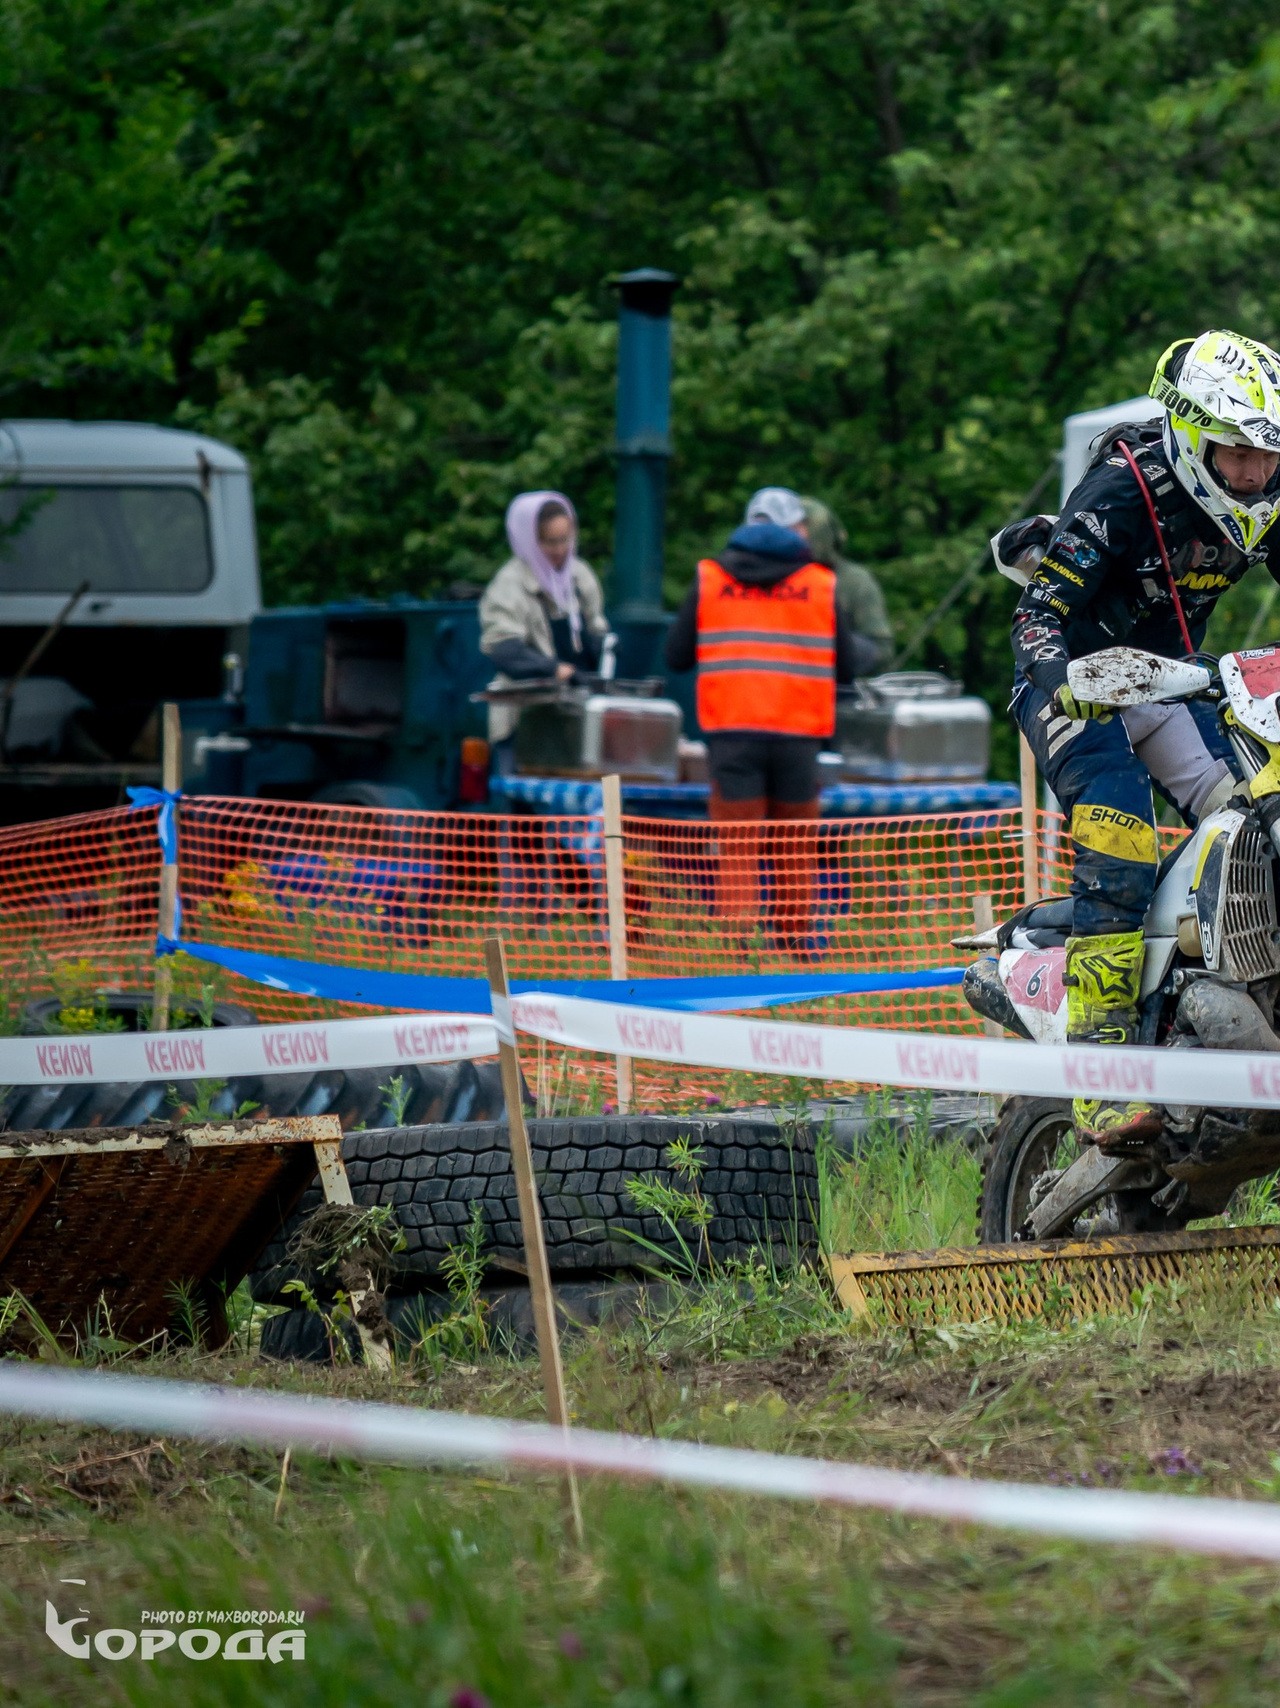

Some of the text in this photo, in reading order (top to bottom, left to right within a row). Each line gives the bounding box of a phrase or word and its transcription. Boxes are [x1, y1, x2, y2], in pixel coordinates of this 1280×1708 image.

[1156, 383, 1213, 427] 100%
[1041, 556, 1084, 587] MANNOL
[1031, 588, 1070, 616] MULTI MOTO
[1090, 807, 1140, 831] SHOT
[1026, 964, 1049, 998] 6
